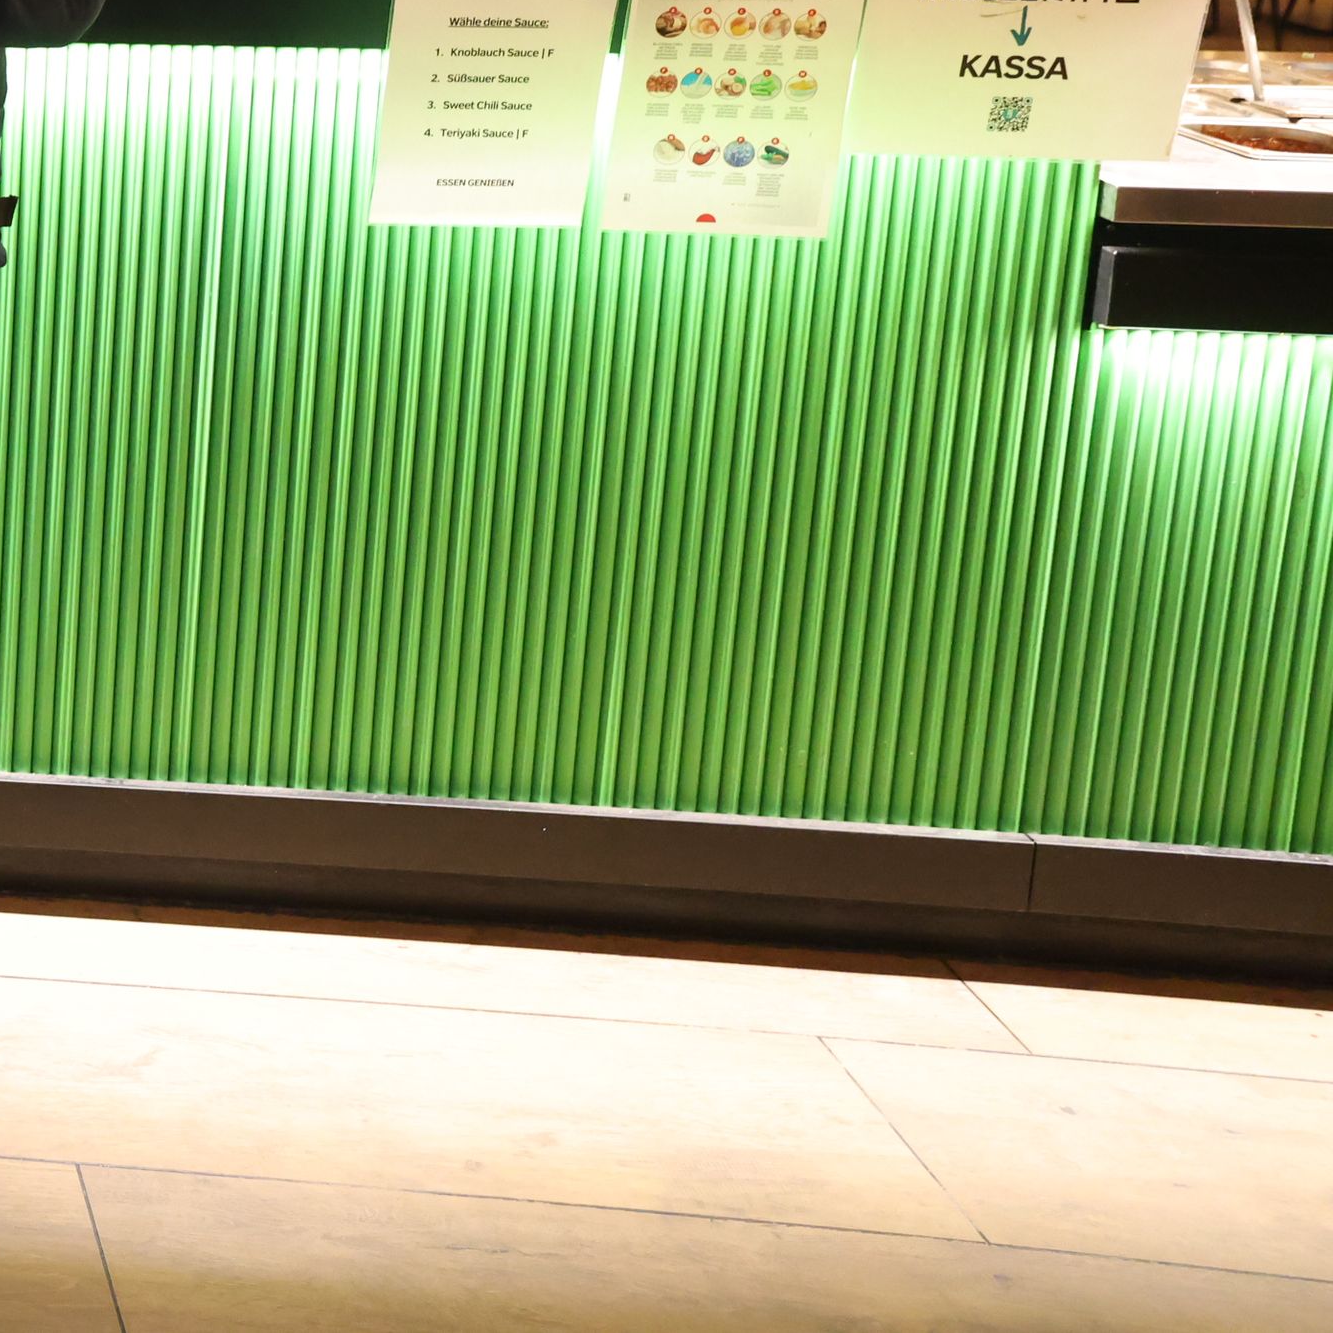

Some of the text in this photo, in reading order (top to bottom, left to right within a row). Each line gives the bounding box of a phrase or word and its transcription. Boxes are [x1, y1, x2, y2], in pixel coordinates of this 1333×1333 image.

[449, 17, 550, 28] Wähle deine Sauce:
[435, 48, 444, 57] 1.
[451, 48, 505, 58] Knoblauch
[507, 49, 540, 58] Sauce
[547, 48, 554, 57] F
[959, 55, 1068, 80] KASSA
[431, 74, 530, 84] 2. Süßsauer Sauce
[427, 101, 533, 111] 3. Sweet Chili Sauce
[424, 128, 433, 137] 4.
[440, 128, 480, 139] Teriyaki
[482, 128, 514, 138] Sauce
[522, 129, 529, 138] F
[436, 179, 466, 187] ESSEN
